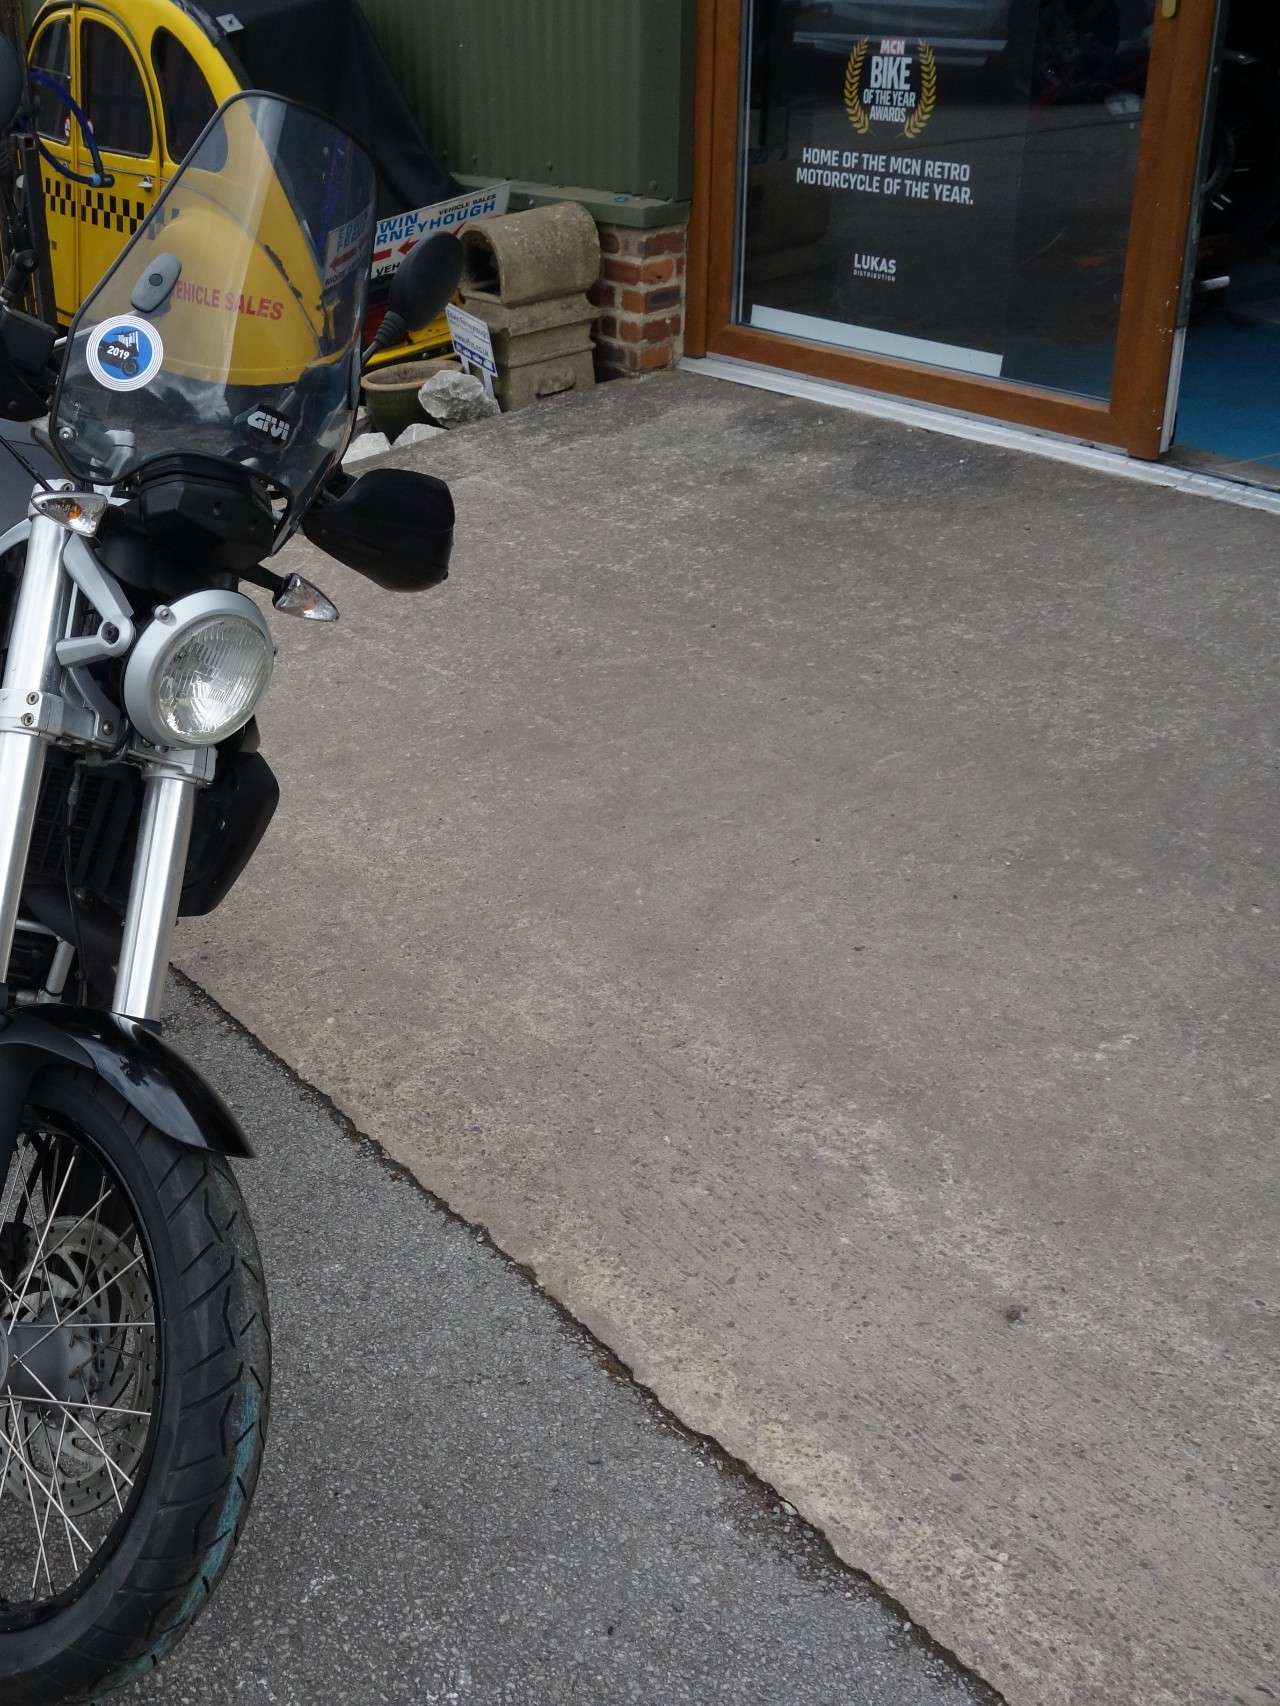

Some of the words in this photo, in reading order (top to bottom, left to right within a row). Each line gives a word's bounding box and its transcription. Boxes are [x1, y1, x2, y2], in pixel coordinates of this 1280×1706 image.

[880, 39, 906, 55] MCN
[870, 56, 913, 90] BIKE
[863, 88, 874, 104] OF
[875, 89, 891, 106] THE
[892, 90, 916, 107] YEAR
[869, 105, 906, 123] AWARDS
[802, 147, 839, 167] HOME
[842, 151, 859, 169] OF
[862, 153, 887, 173] THE
[889, 156, 921, 176] MCN
[924, 160, 970, 182] RETRO
[796, 167, 880, 193] MOTORCYCLE
[884, 178, 901, 195] OF
[904, 180, 930, 200] THE
[933, 183, 974, 205] YEAR.
[439, 202, 471, 216] VEHICLE
[472, 193, 497, 207] SALES
[376, 212, 419, 235] WIN
[854, 253, 896, 274] LUKAS
[853, 269, 896, 282] DISTRIBUTION
[225, 292, 285, 320] SALES
[106, 345, 130, 360] 2019
[247, 410, 291, 441] GIVI
